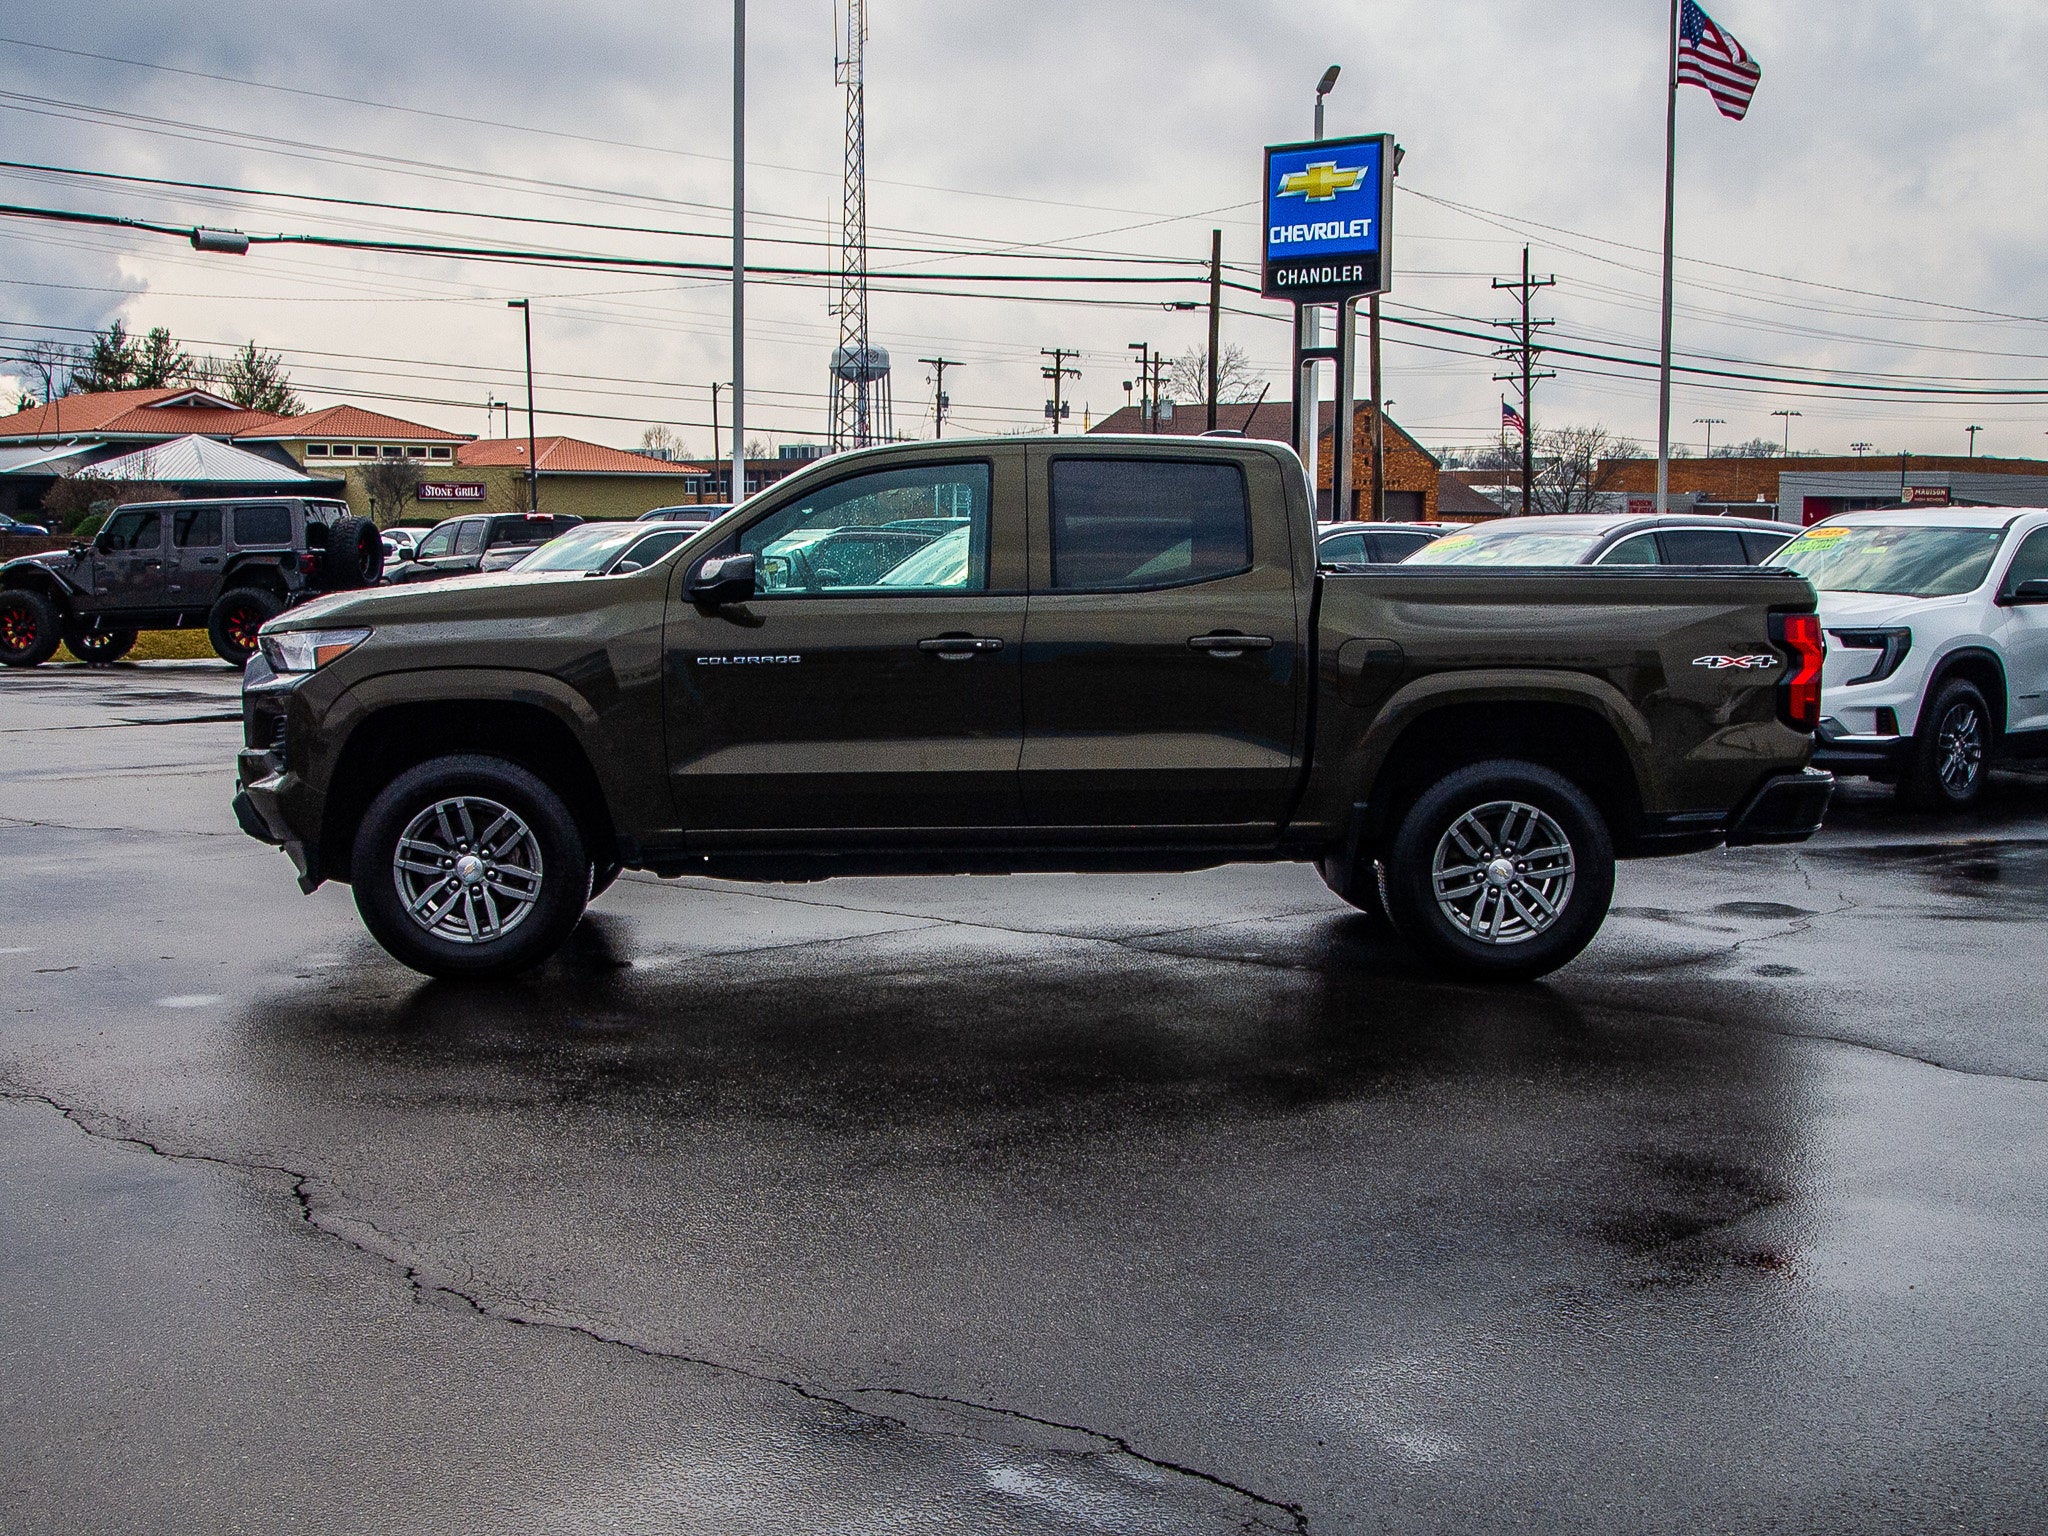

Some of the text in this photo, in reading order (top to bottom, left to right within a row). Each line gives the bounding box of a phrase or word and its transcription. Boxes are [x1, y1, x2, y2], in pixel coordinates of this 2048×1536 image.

[1269, 218, 1372, 244] CHEVROLET
[1277, 264, 1363, 286] CHANDLER
[425, 484, 480, 497] STONE GRILL
[697, 655, 801, 665] COLORADO
